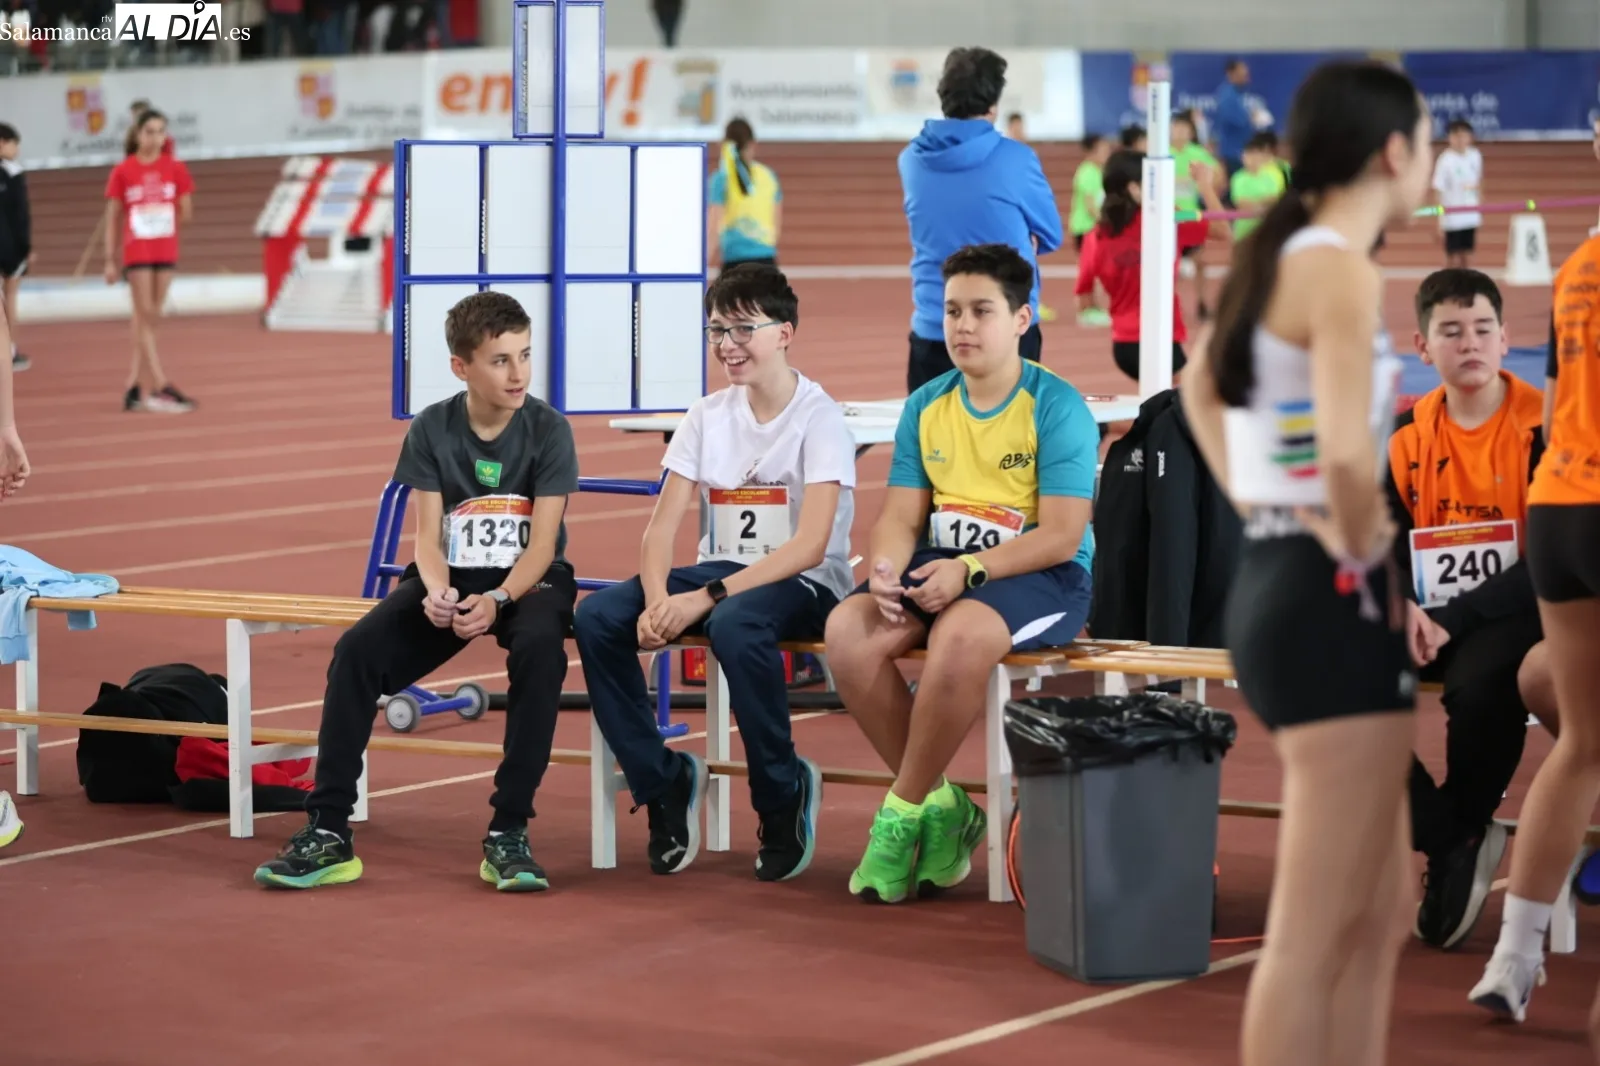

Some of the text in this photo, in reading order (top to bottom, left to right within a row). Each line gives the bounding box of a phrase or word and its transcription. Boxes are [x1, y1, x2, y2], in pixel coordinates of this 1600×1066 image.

[461, 518, 531, 549] 1320
[740, 510, 757, 539] 2
[1437, 549, 1502, 585] 240
